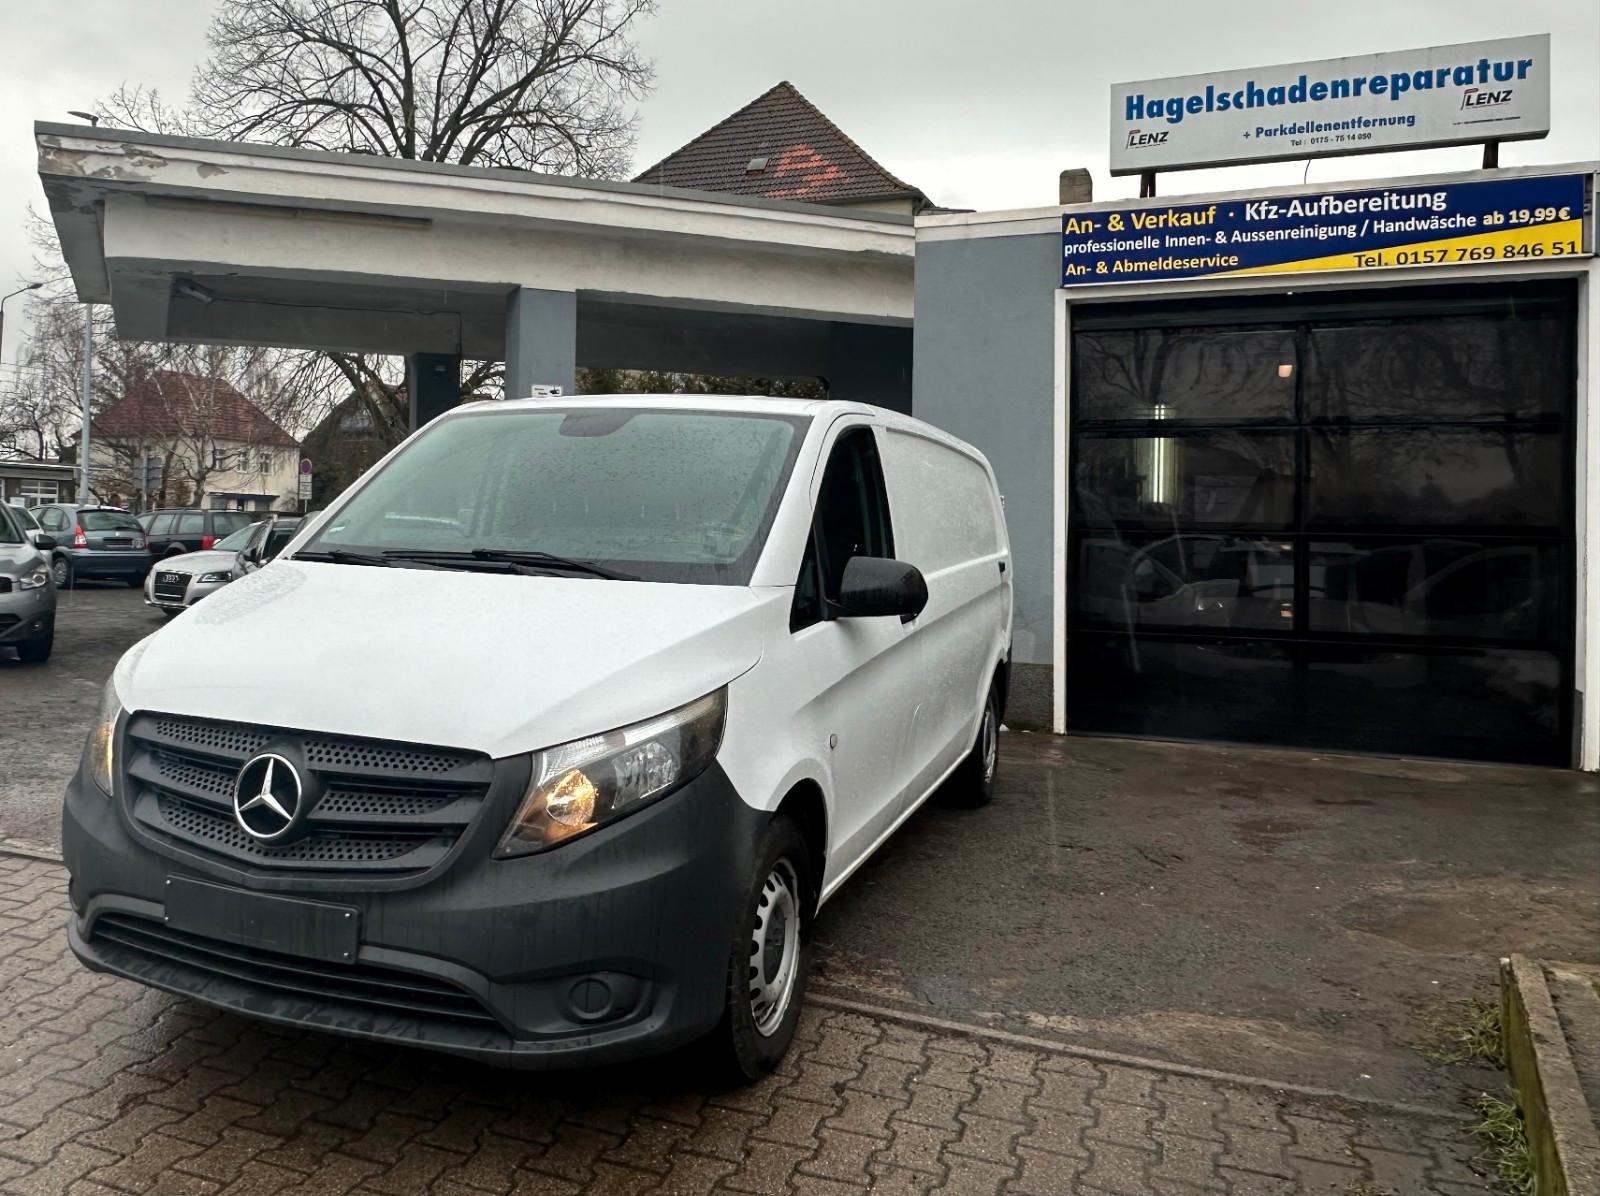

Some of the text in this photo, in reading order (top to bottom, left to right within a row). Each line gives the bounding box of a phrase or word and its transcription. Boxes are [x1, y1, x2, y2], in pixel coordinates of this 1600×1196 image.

[1125, 58, 1533, 124] Hagelschadenreparatur
[1464, 89, 1513, 107] LENZ
[1255, 114, 1416, 138] Parkdellenentfernung
[1129, 131, 1169, 147] LENZ
[1310, 136, 1329, 145] 0175
[1065, 191, 1447, 235] An- & Verkauf Kfz-Aufbereitung
[1064, 236, 1160, 257] professionelle
[1165, 234, 1212, 248] Innen-
[1215, 231, 1227, 244] &
[1231, 224, 1357, 243] Aussenreinigung
[1373, 213, 1477, 234] Handwäsche
[1483, 210, 1505, 226] ab
[1065, 253, 1239, 276] An- & Abmeldeservice
[1353, 240, 1579, 268] Tel. 0157 769 846 51
